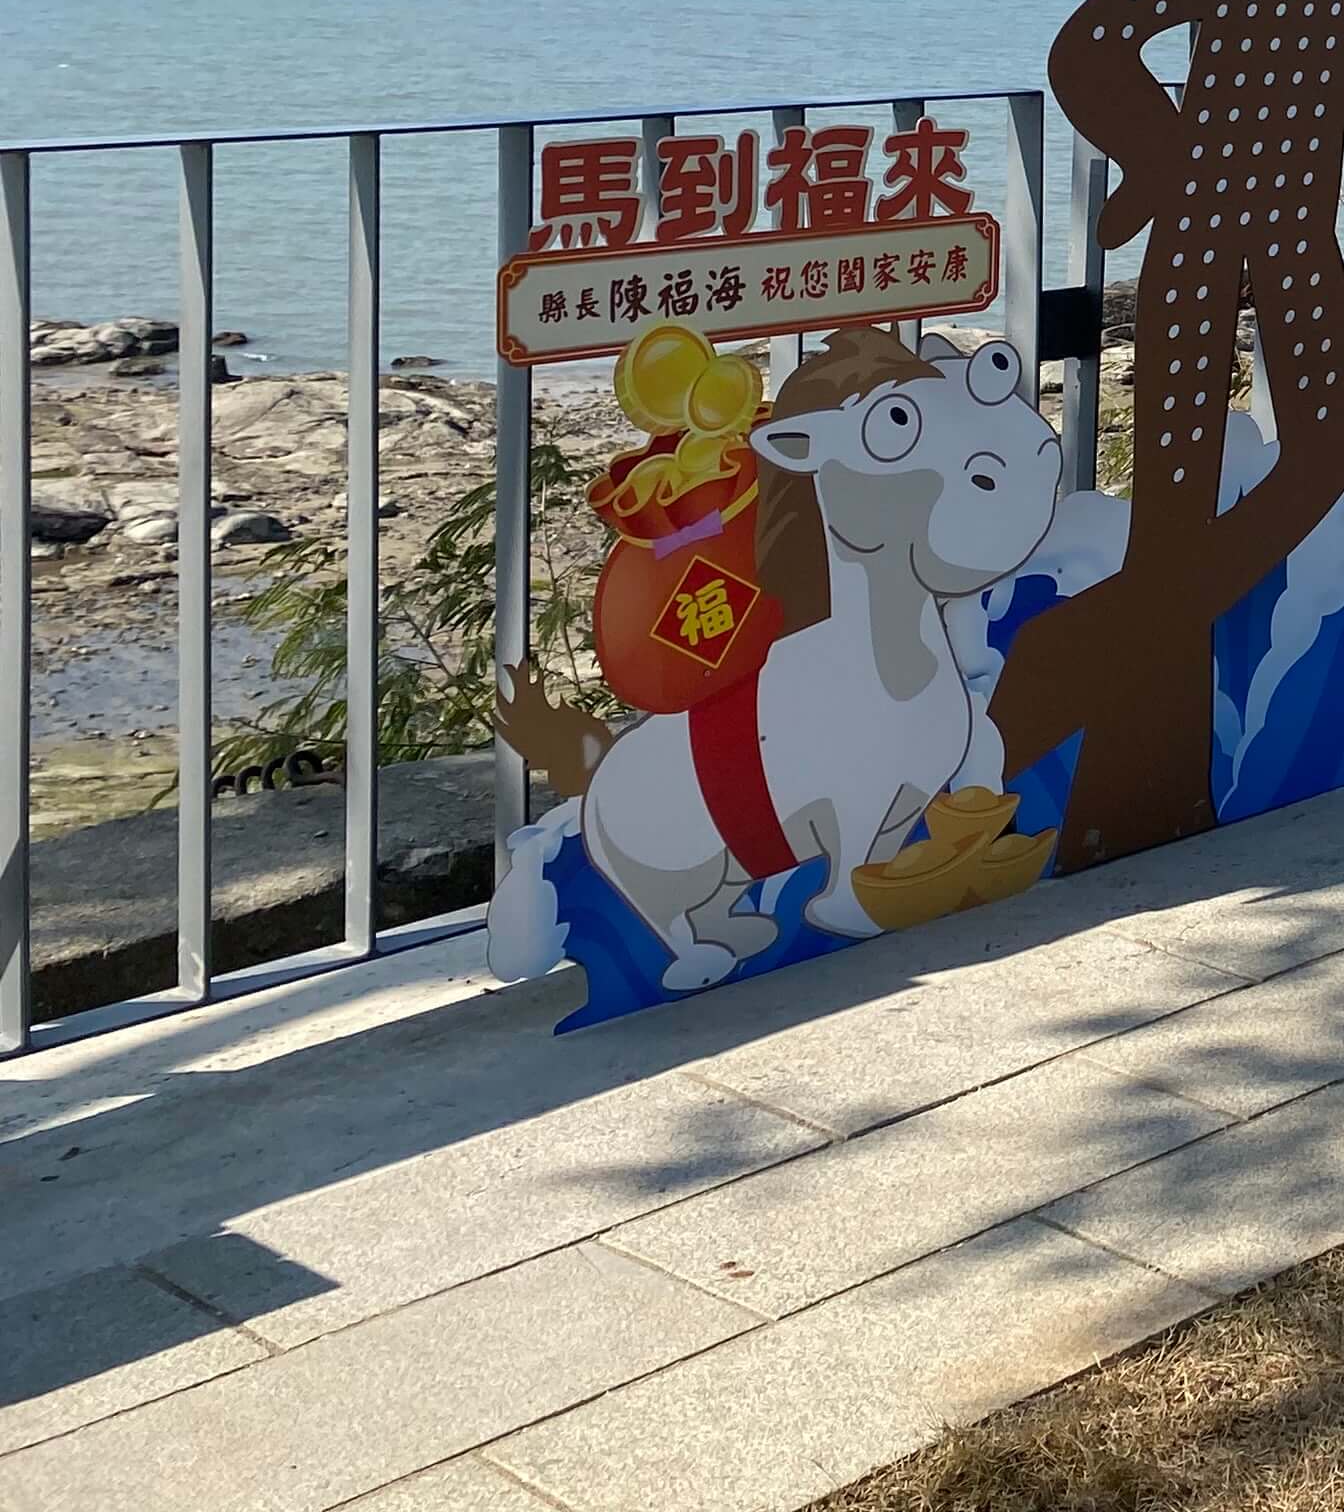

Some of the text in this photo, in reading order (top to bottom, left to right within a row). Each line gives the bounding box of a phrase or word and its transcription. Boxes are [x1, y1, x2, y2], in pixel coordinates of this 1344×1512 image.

[530, 118, 974, 251] 馬到福來
[676, 579, 734, 646] 福
